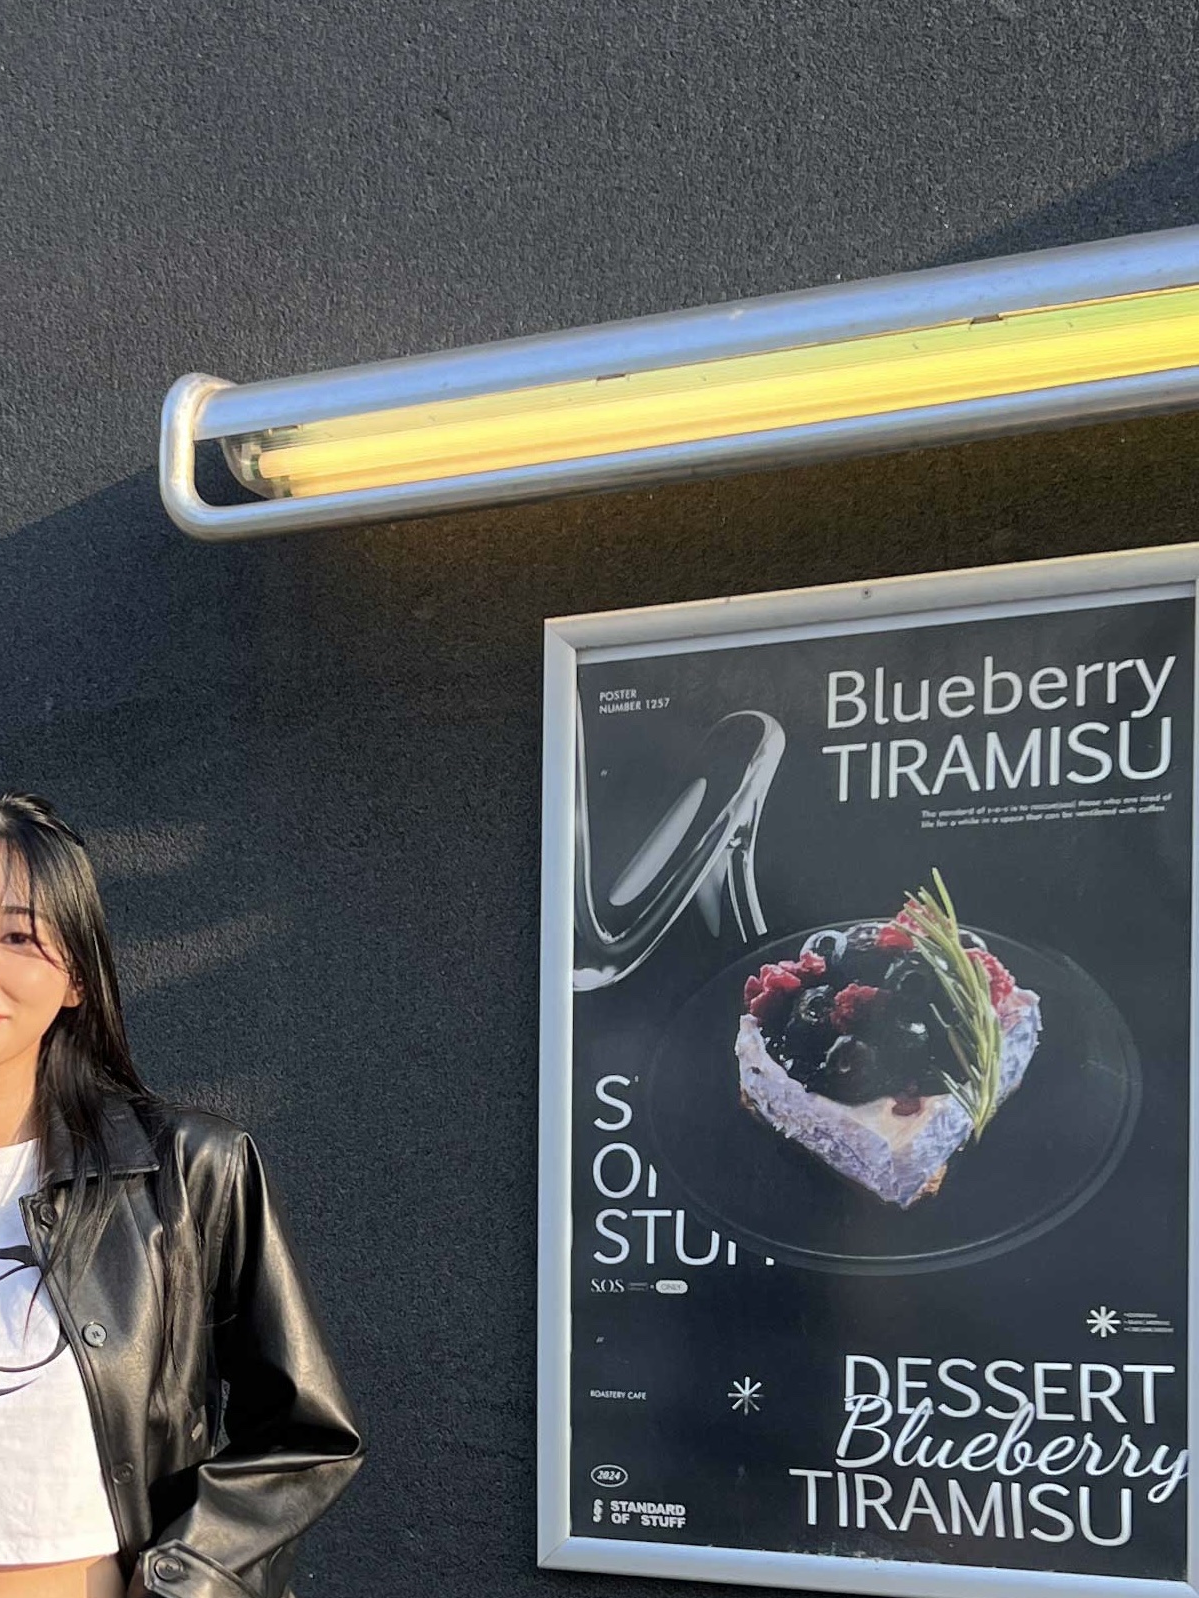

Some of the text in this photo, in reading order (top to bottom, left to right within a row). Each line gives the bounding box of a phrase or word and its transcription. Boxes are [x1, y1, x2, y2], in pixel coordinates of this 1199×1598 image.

[598, 697, 670, 714] NUMBER 1257
[599, 689, 637, 701] POSTER
[827, 656, 1176, 729] Blueberry
[822, 716, 1172, 802] TIRAMISU
[590, 1389, 647, 1400] ROASTERY CAFE
[844, 1354, 1176, 1424] DESSERT
[835, 1394, 1190, 1504] Blueberry
[610, 1500, 686, 1516] STANDARD
[610, 1513, 686, 1529] OF STUFF
[788, 1468, 1132, 1547] TIRAMISU
